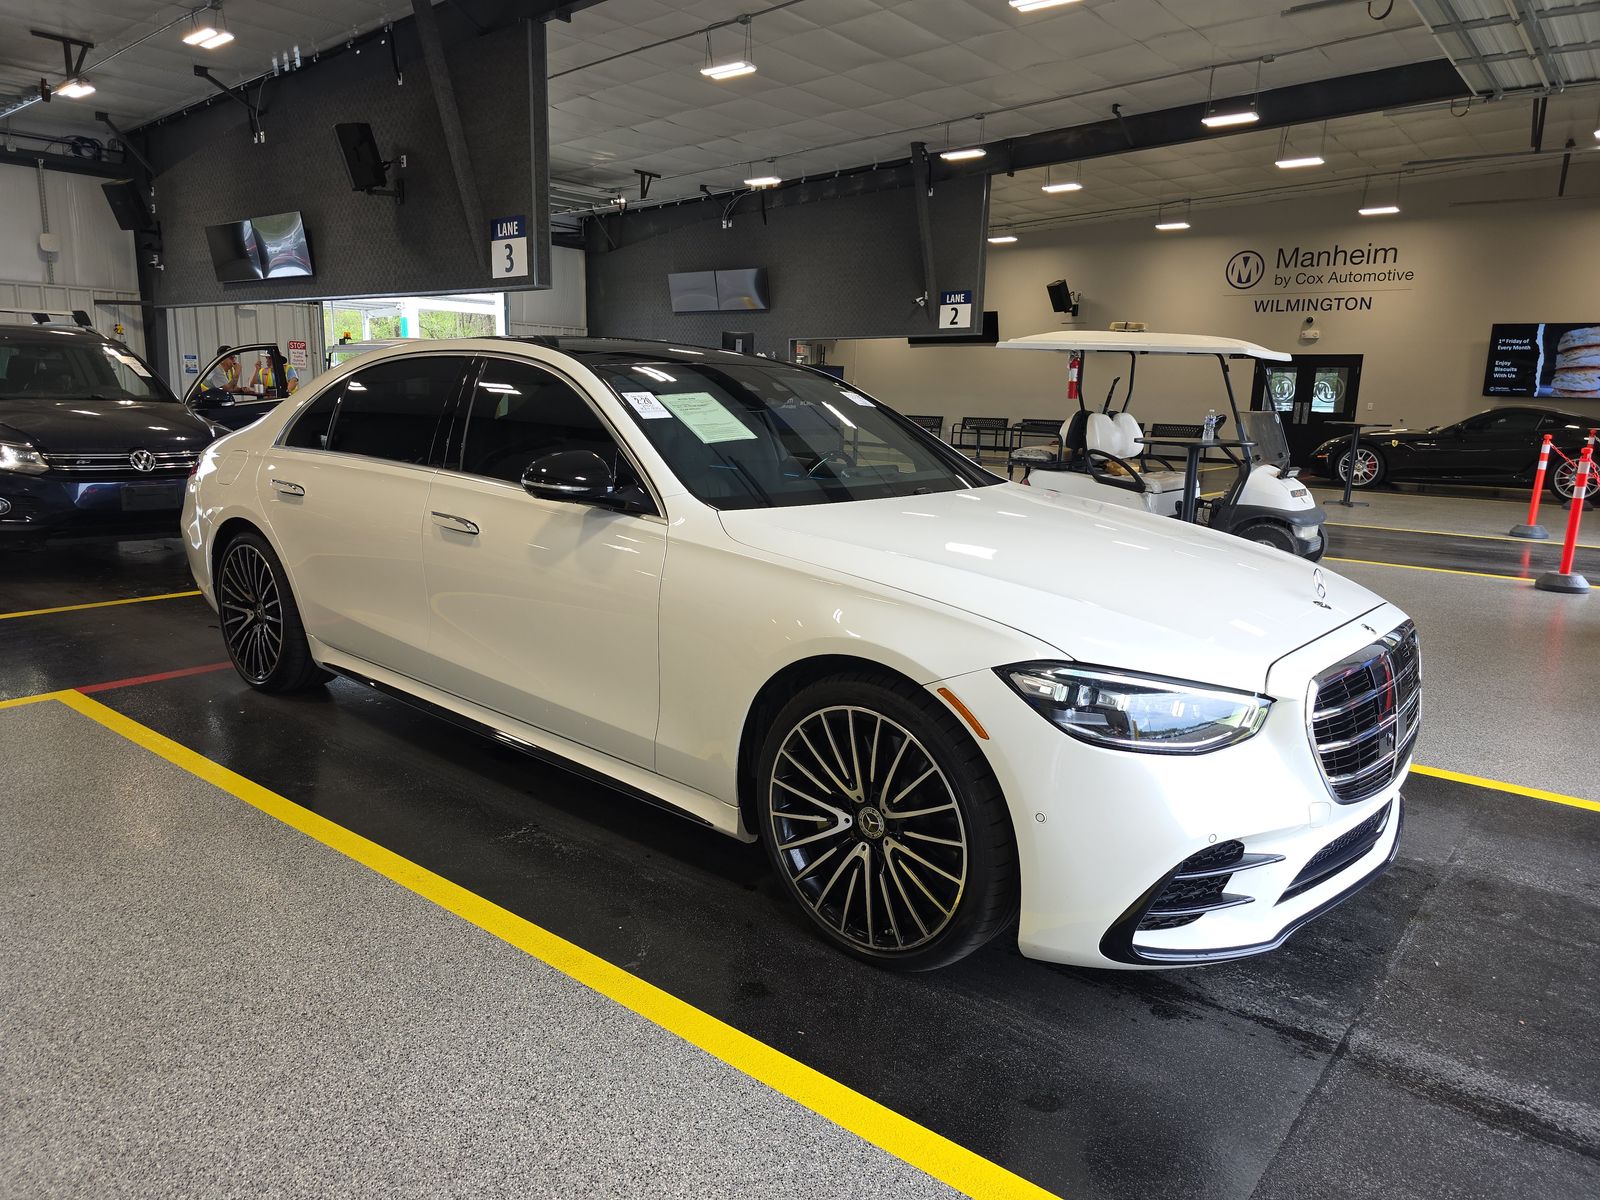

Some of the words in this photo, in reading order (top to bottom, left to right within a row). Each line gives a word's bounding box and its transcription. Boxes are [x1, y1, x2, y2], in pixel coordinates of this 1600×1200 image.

[497, 221, 519, 237] LANE
[504, 243, 515, 273] 3
[1276, 242, 1398, 269] Manheim
[1274, 274, 1291, 288] by
[1295, 272, 1323, 285] Cox
[1327, 268, 1414, 284] Automotive
[946, 293, 965, 304] LANE
[1254, 297, 1373, 313] WILMINGTON
[949, 307, 959, 326] 2
